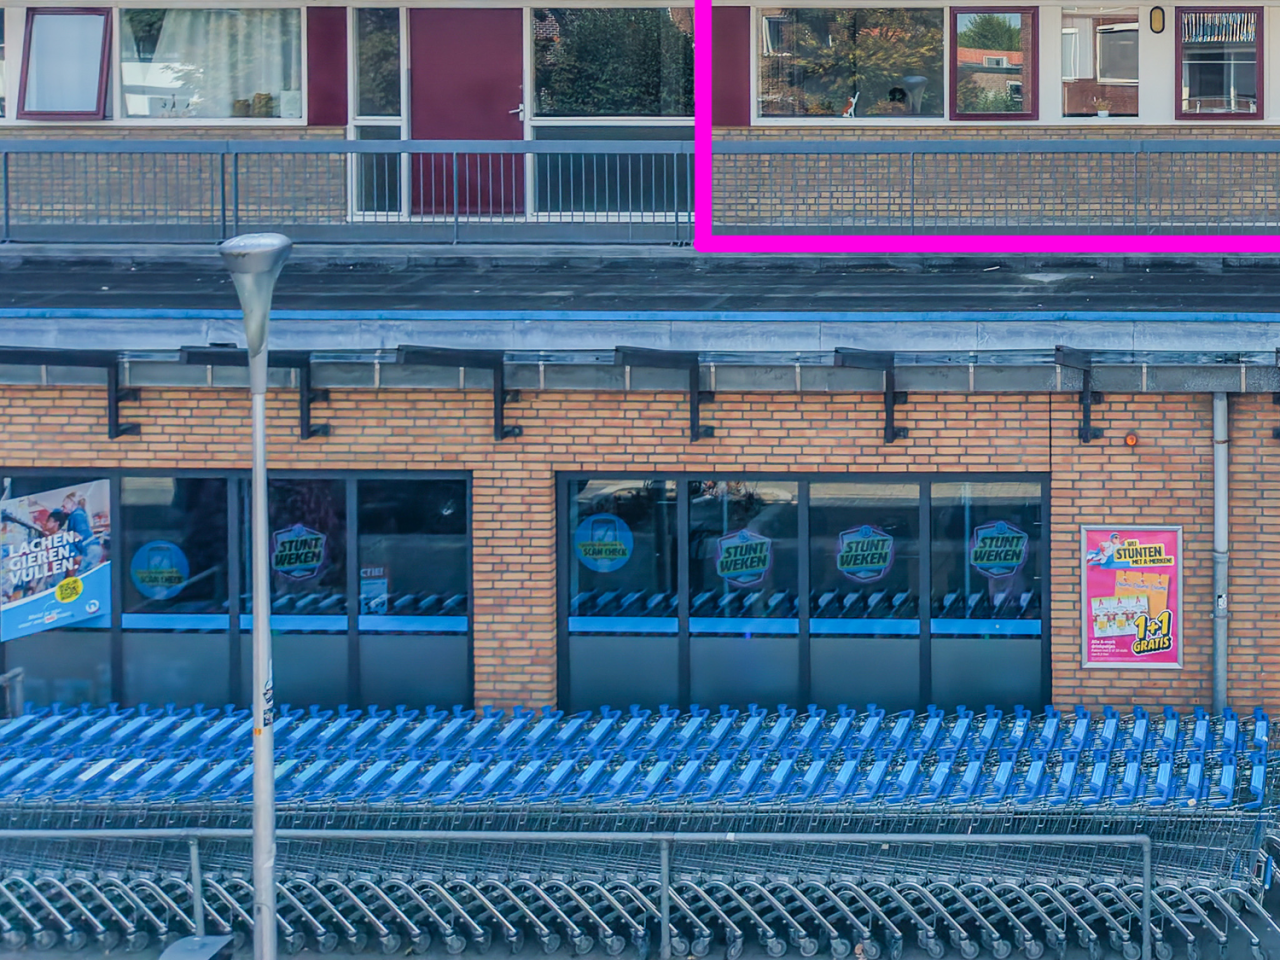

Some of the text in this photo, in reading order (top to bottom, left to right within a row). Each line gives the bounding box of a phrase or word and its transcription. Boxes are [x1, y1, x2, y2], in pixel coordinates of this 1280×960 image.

[9, 530, 80, 558] LACHEN.
[279, 537, 321, 553] STUNT
[724, 541, 766, 559] STUNT
[845, 538, 889, 554] STUNT
[980, 535, 1023, 549] STUNT
[9, 545, 75, 571] GIEREN.
[274, 549, 321, 566] WEKEN
[583, 547, 628, 557] SCAN CHECK
[840, 551, 888, 567] WEKEN
[973, 549, 1022, 562] WEKEN
[1116, 546, 1162, 560] STUNTEN
[9, 558, 79, 585] VULLEN.
[720, 555, 767, 572] WEKEN
[1134, 611, 1171, 640] 1+1
[1133, 636, 1170, 653] GRATIS
